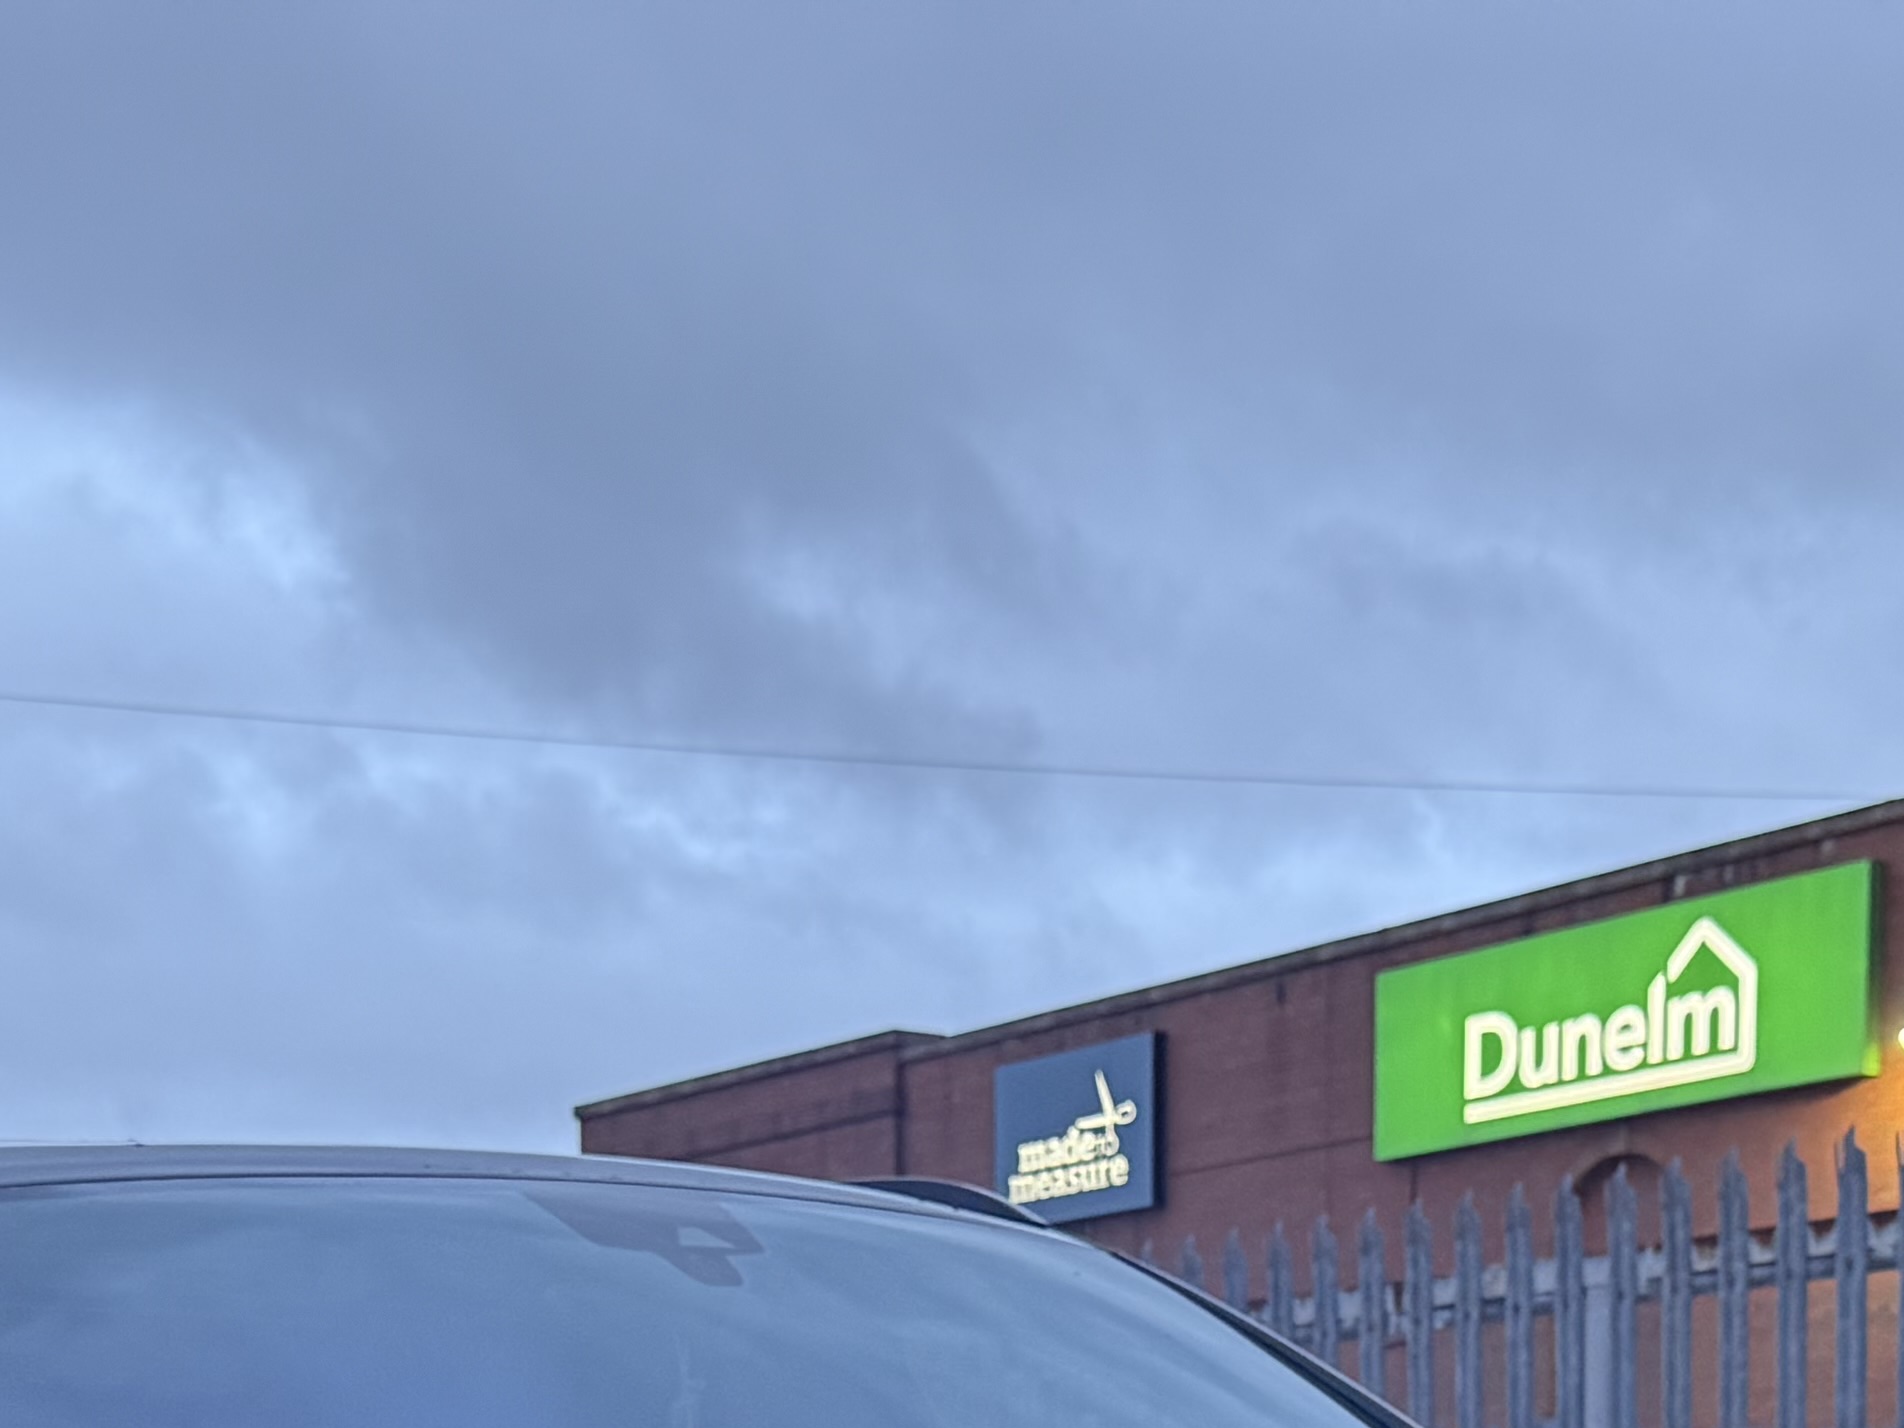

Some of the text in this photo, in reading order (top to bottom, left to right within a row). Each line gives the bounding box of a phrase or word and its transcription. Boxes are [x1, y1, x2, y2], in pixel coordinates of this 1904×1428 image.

[1463, 971, 1738, 1101] Dunelm
[1016, 1125, 1097, 1173] made
[1008, 1153, 1130, 1205] measure
